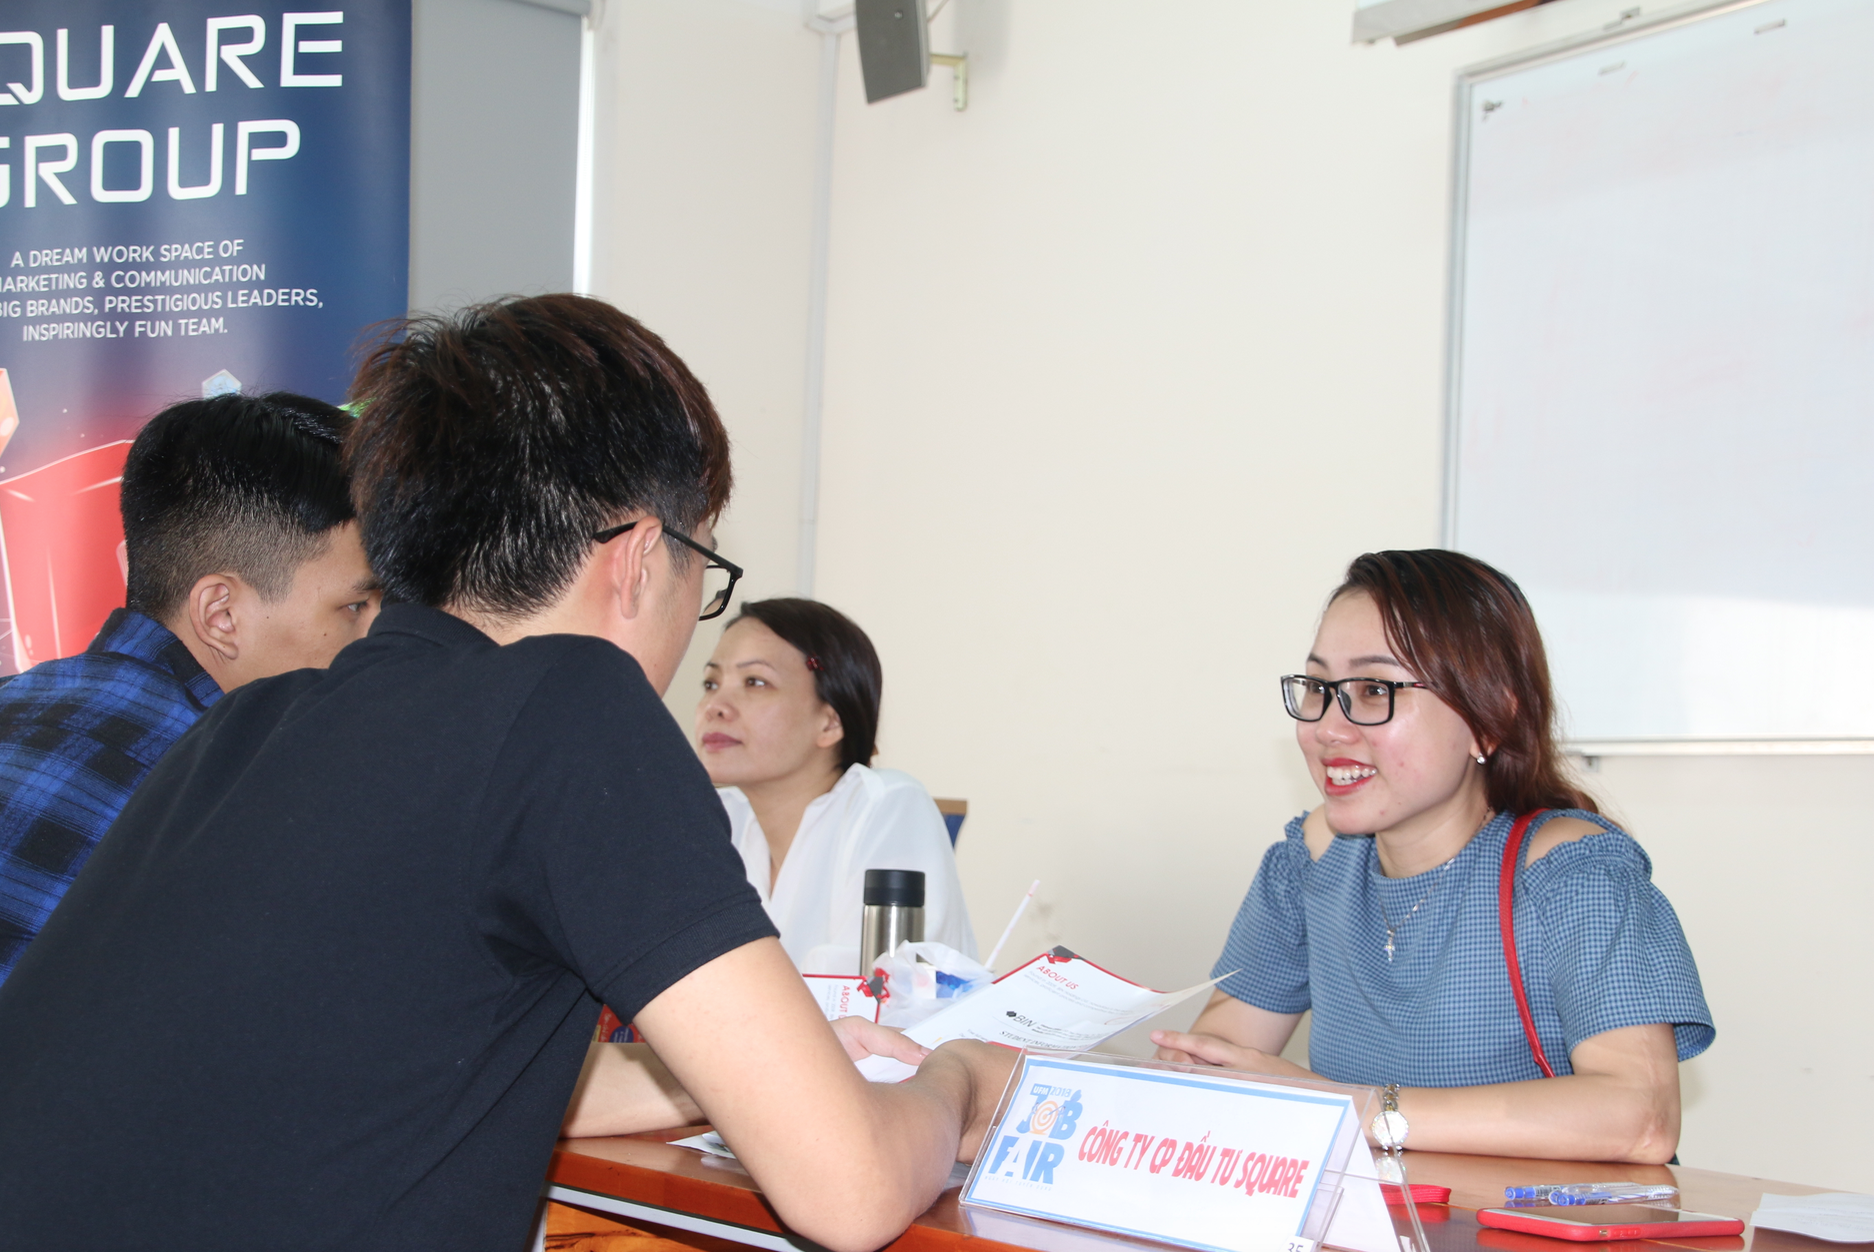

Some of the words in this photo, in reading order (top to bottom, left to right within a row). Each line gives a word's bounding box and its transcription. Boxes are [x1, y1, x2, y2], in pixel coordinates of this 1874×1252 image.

[0, 118, 301, 208] ROUP
[10, 251, 24, 268] A
[29, 247, 87, 268] DREAM
[93, 245, 155, 264] WORK
[160, 242, 214, 263] SPACE
[219, 240, 244, 257] OF
[0, 271, 87, 293] ARKETING
[92, 271, 105, 288] &
[111, 264, 265, 289] COMMUNICATION
[26, 296, 98, 317] BRANDS,
[104, 292, 222, 314] PRESTIGIOUS
[227, 289, 324, 309] LEADERS,
[23, 321, 128, 342] INSPIRINGLY
[134, 319, 174, 338] FUN
[178, 317, 228, 336] TEAM.
[1037, 966, 1068, 984] ABOUT
[1064, 979, 1079, 990] US
[839, 984, 851, 1013] ABOUT
[1013, 1014, 1037, 1028] BIN
[1033, 1085, 1050, 1096] UFM
[1049, 1086, 1072, 1098] 2018
[988, 1135, 1065, 1185] FAIR
[1077, 1120, 1130, 1167] CÔNG
[1123, 1133, 1156, 1171] TY
[1149, 1137, 1178, 1175] CP
[1233, 1151, 1311, 1198] SQUARE
